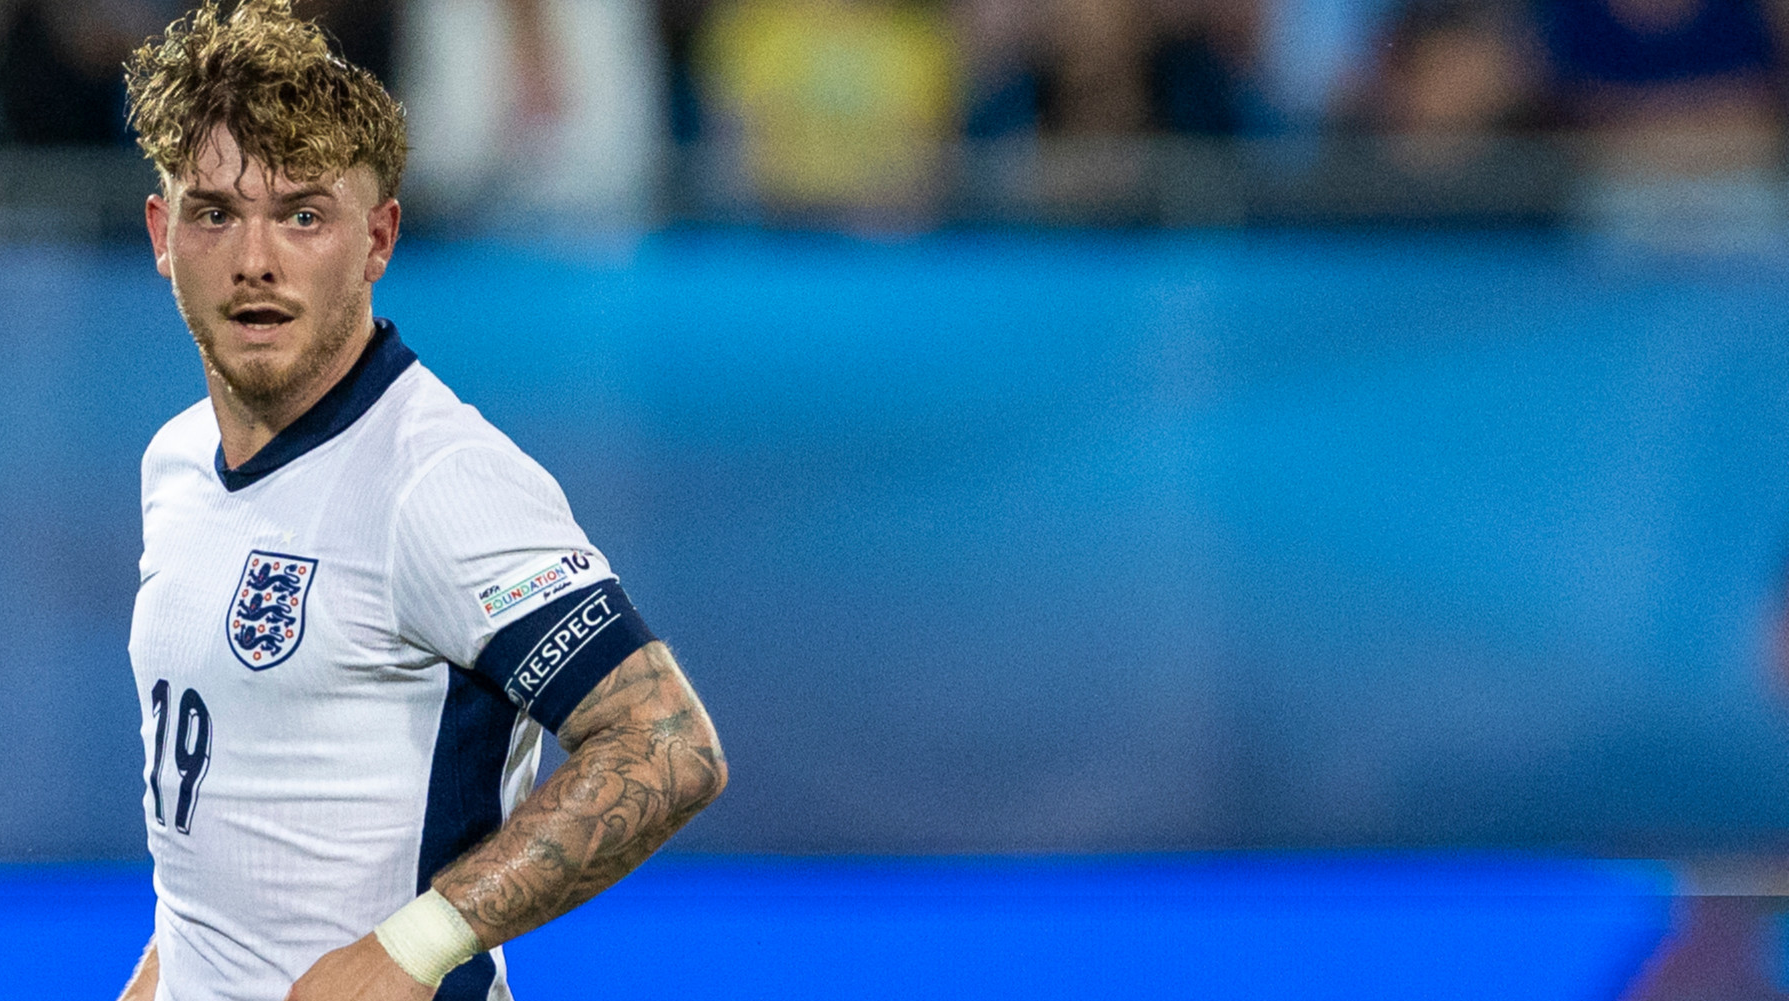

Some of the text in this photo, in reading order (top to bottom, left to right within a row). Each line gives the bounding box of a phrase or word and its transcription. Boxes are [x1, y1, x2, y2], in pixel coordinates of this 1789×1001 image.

[479, 585, 500, 600] UEFA
[484, 566, 566, 614] FOUNDATION
[518, 595, 612, 692] RESPECT
[151, 678, 212, 835] 19
